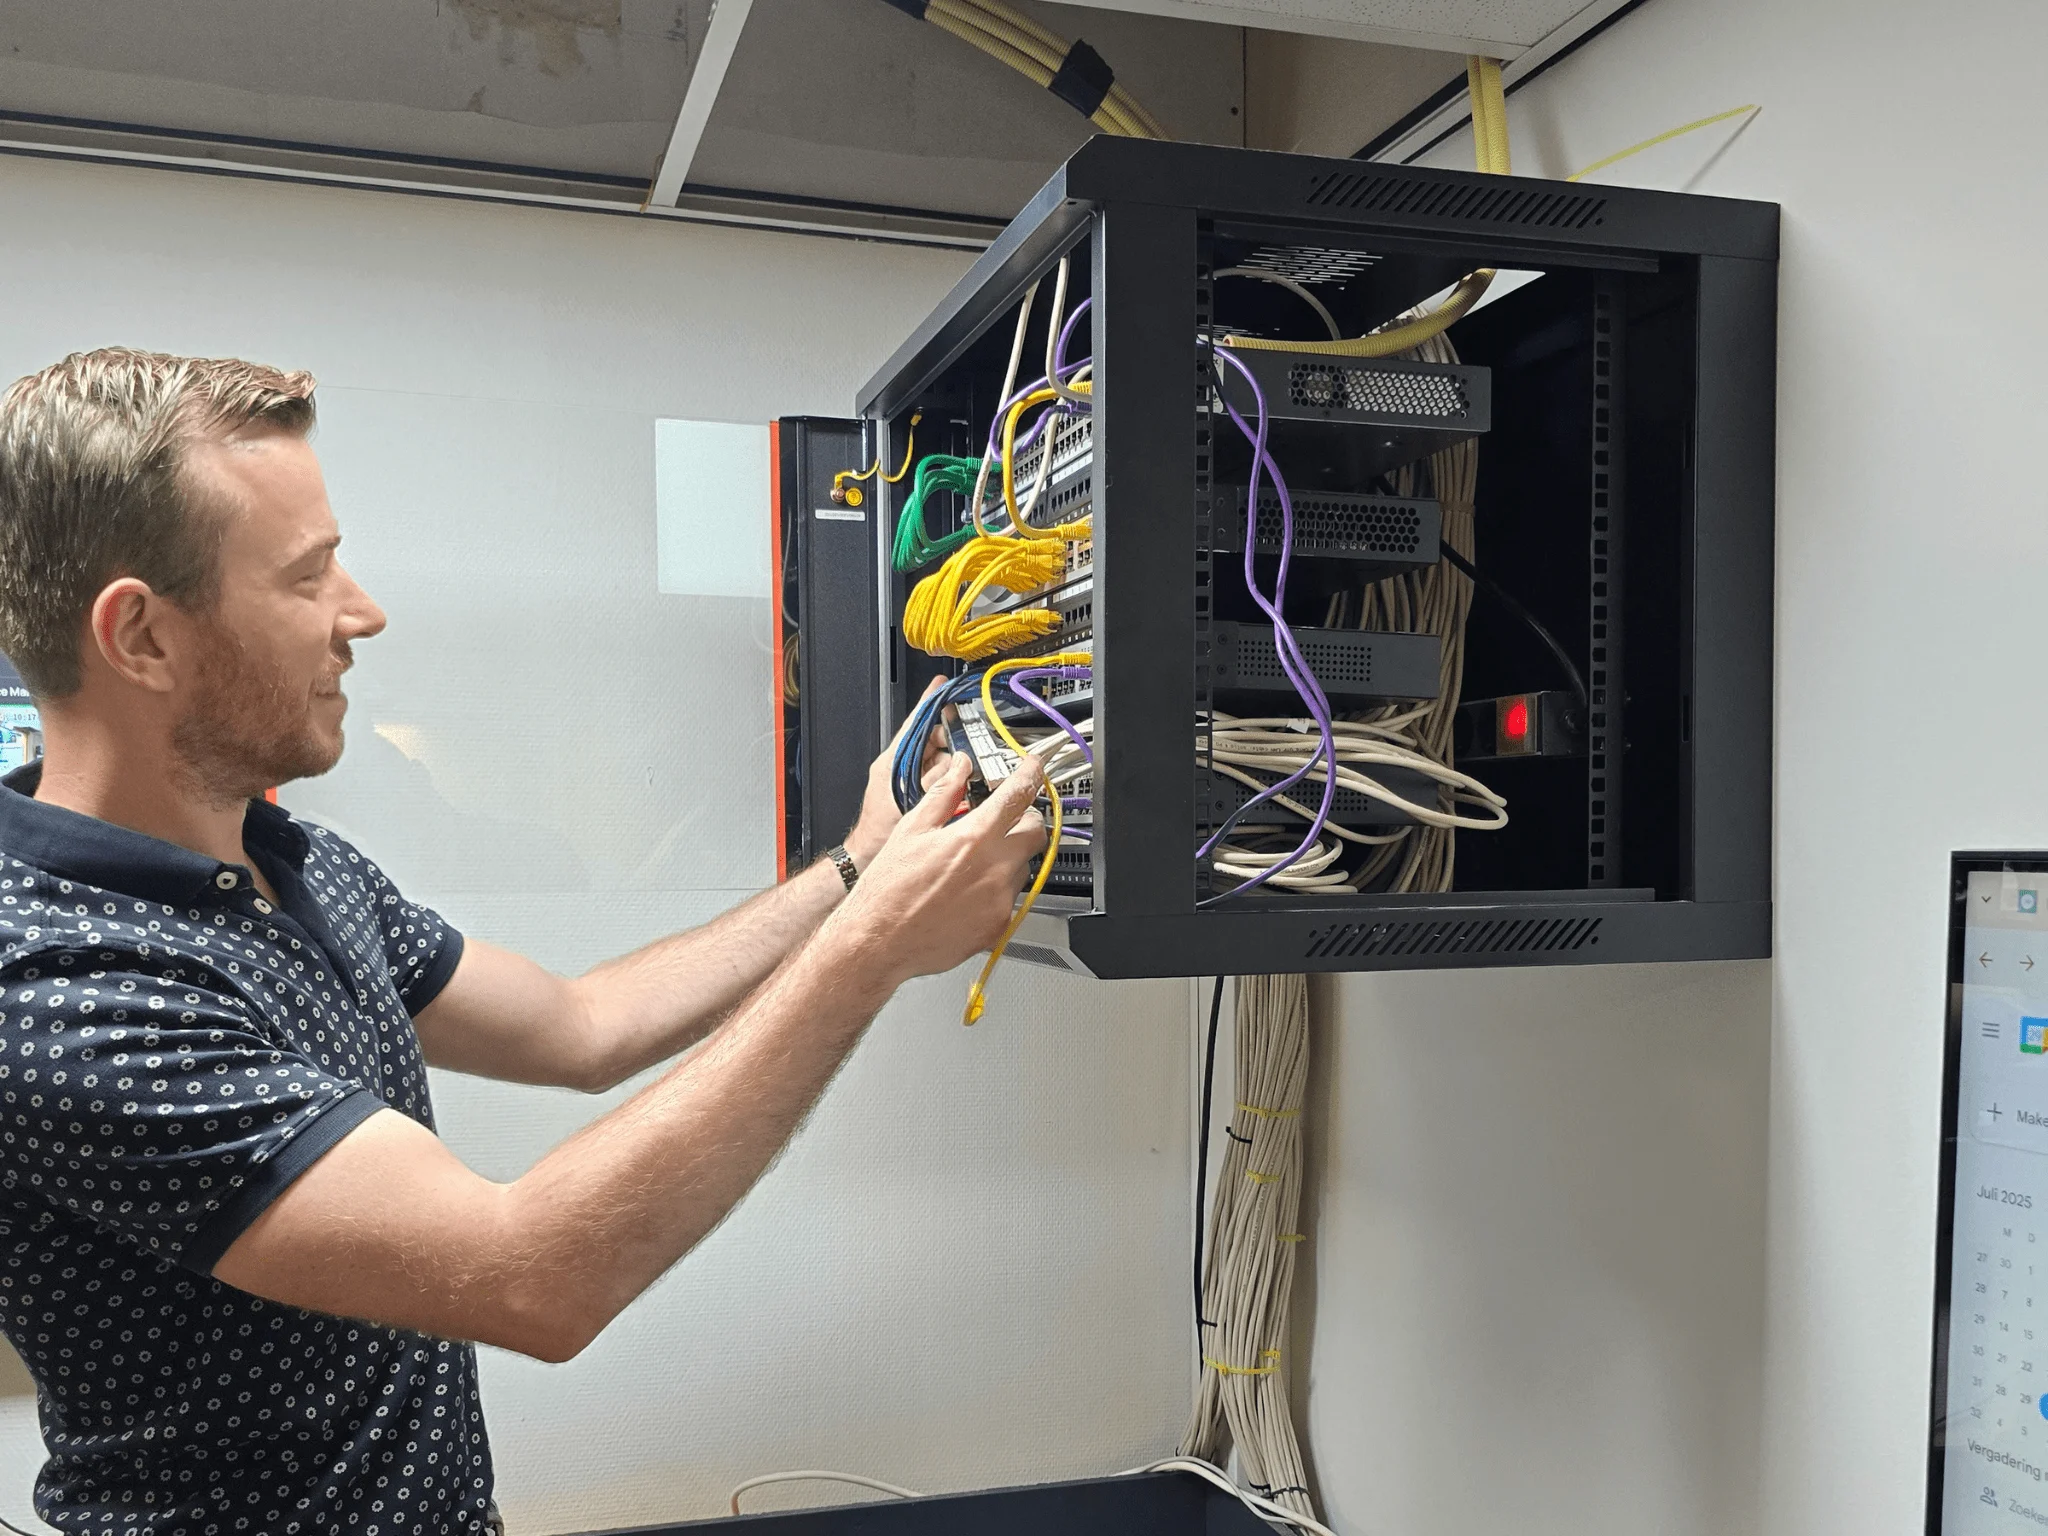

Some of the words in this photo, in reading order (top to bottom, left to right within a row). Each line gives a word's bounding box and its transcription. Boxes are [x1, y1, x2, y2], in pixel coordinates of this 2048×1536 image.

[2016, 1109, 2048, 1127] Make
[1976, 1185, 1998, 1201] Juli
[2001, 1190, 2032, 1209] 2025
[2003, 1226, 2012, 1238] M
[2028, 1231, 2036, 1244] D
[1999, 1257, 2012, 1270] 30
[1975, 1282, 1986, 1294] 28
[1973, 1313, 1986, 1325] 29
[2023, 1329, 2033, 1341] 15
[1995, 1384, 2007, 1396] 28
[2019, 1392, 2032, 1404] 29
[1966, 1437, 2042, 1481] Vergadering
